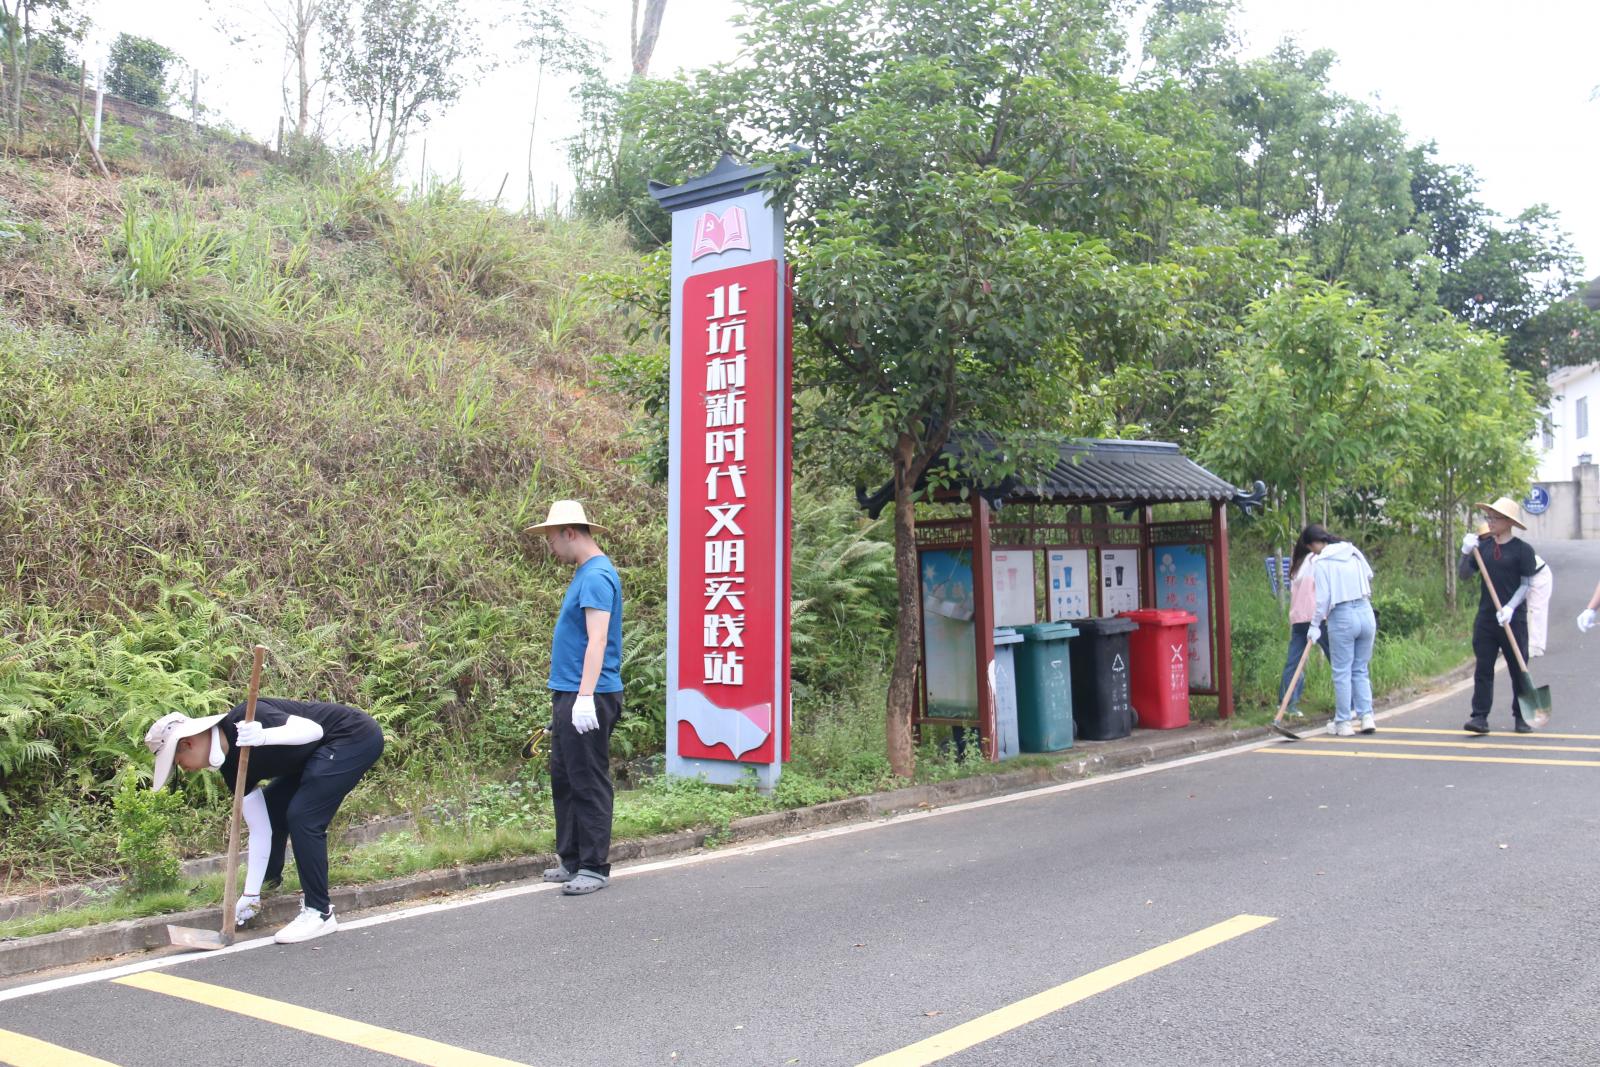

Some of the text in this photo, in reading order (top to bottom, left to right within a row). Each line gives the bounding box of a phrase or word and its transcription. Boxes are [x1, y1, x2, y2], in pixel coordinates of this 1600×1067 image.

[703, 283, 747, 685] 北坑村新时代文明实践站
[1531, 489, 1540, 500] P
